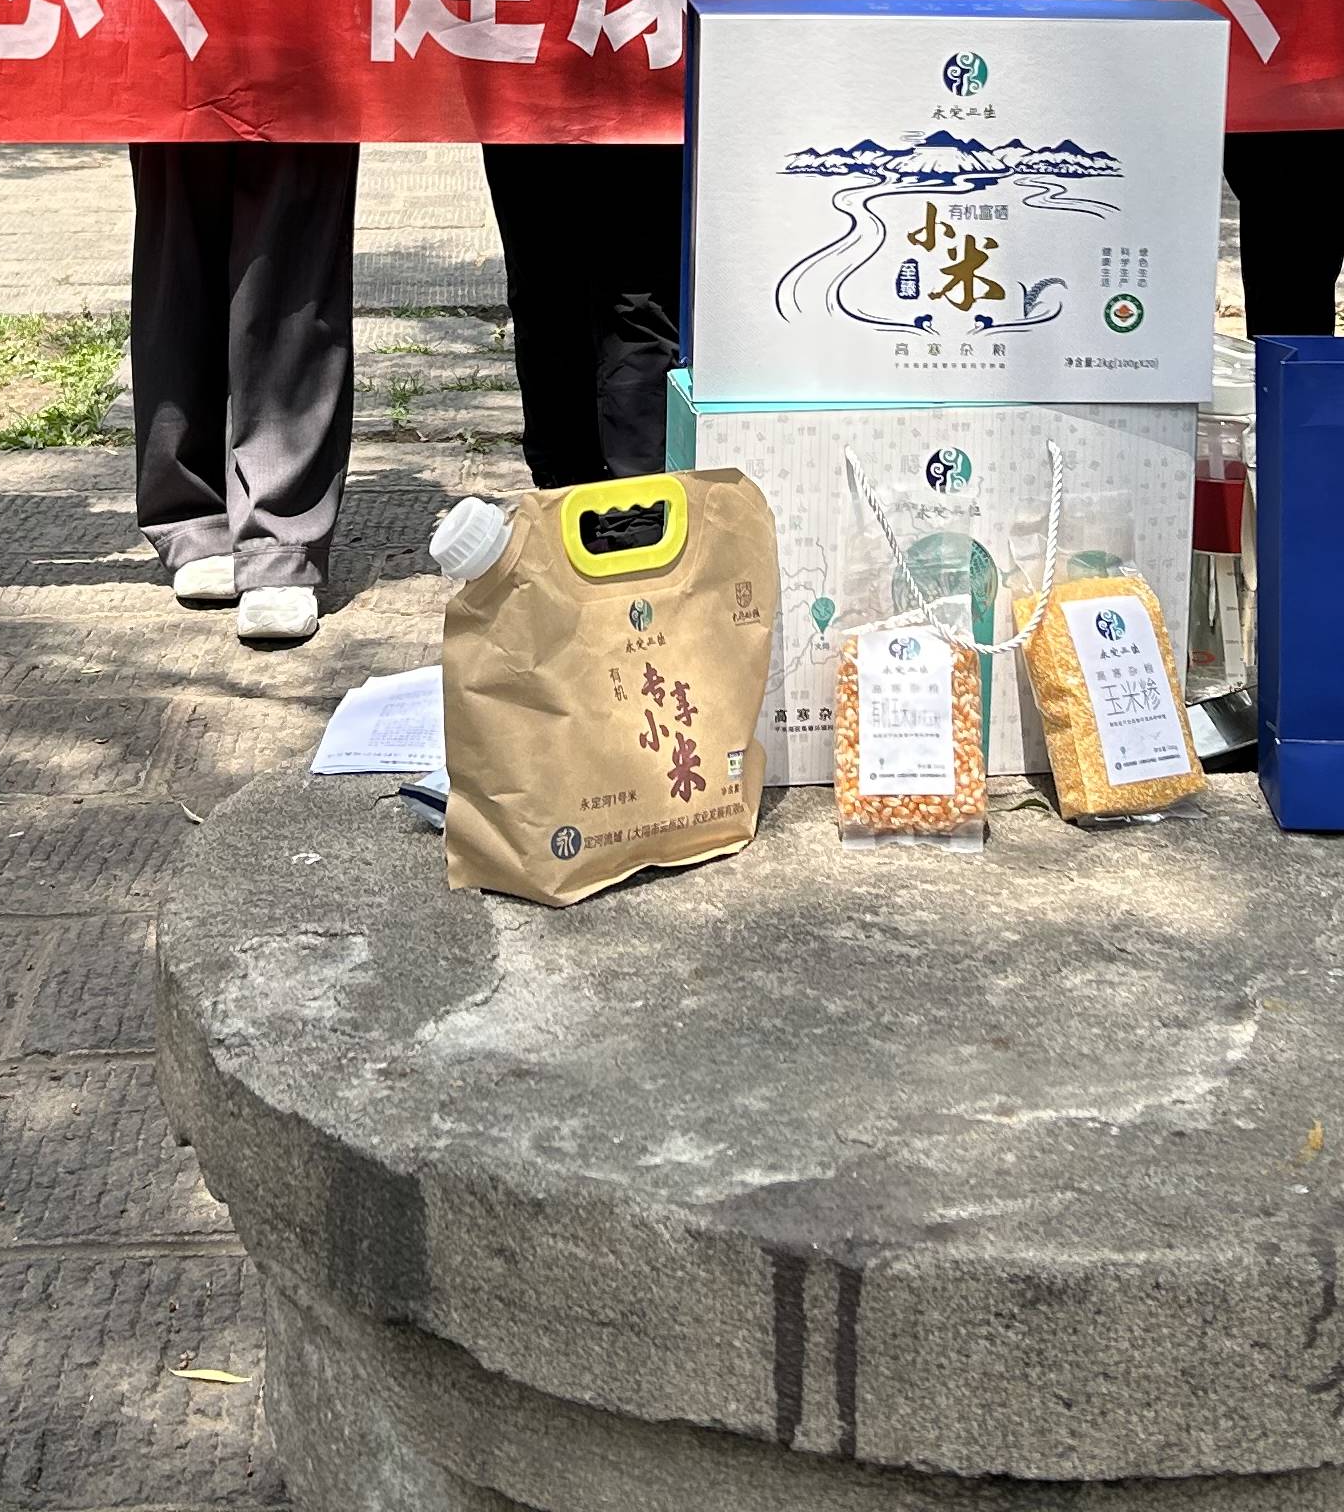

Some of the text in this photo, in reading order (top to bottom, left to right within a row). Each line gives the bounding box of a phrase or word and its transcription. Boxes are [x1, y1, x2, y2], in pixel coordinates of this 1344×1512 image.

[906, 201, 1007, 312] 小米
[608, 667, 628, 702] 有机
[641, 661, 699, 727] 专享
[639, 708, 707, 803] 小米
